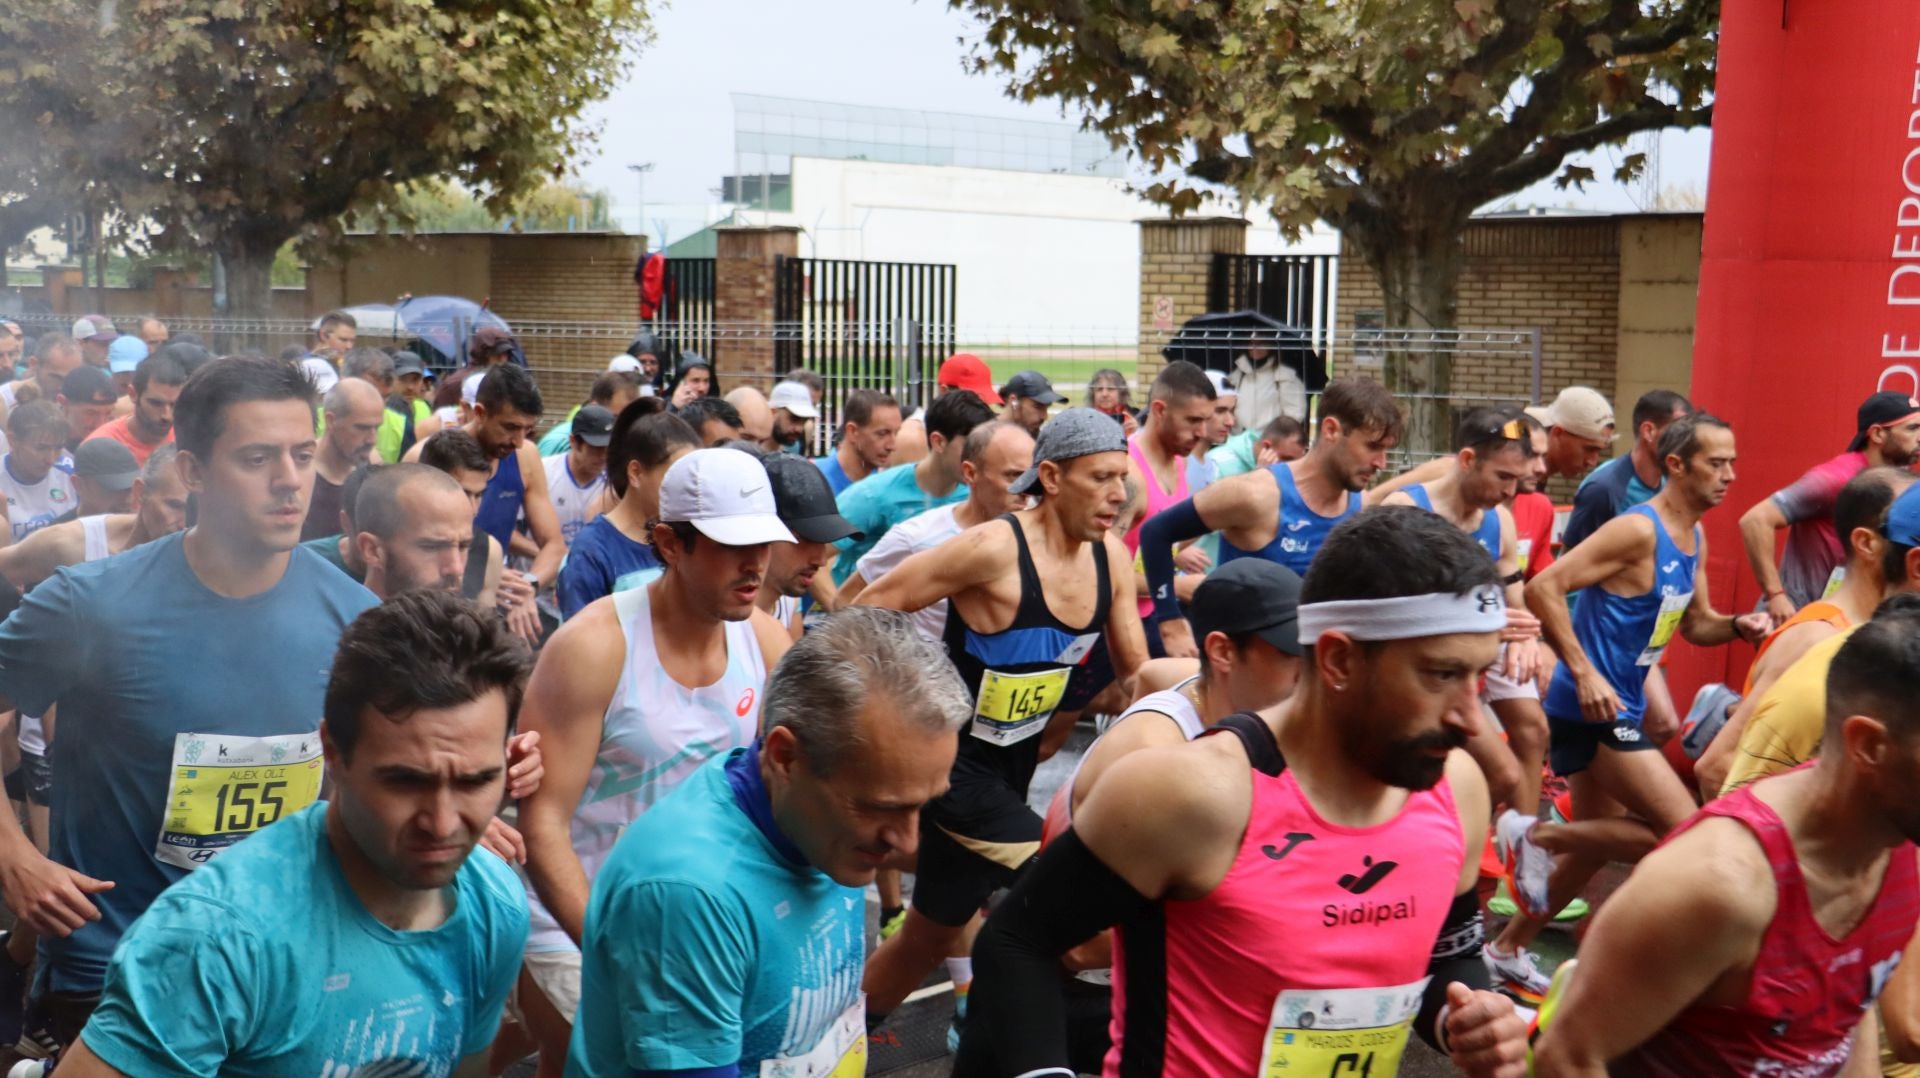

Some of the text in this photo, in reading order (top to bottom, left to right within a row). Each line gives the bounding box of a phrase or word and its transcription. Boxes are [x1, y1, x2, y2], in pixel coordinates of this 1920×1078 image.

[1007, 684, 1046, 720] 145
[228, 768, 287, 781] ALEX OLI
[214, 781, 288, 832] 155
[1322, 895, 1417, 928] Sidipal
